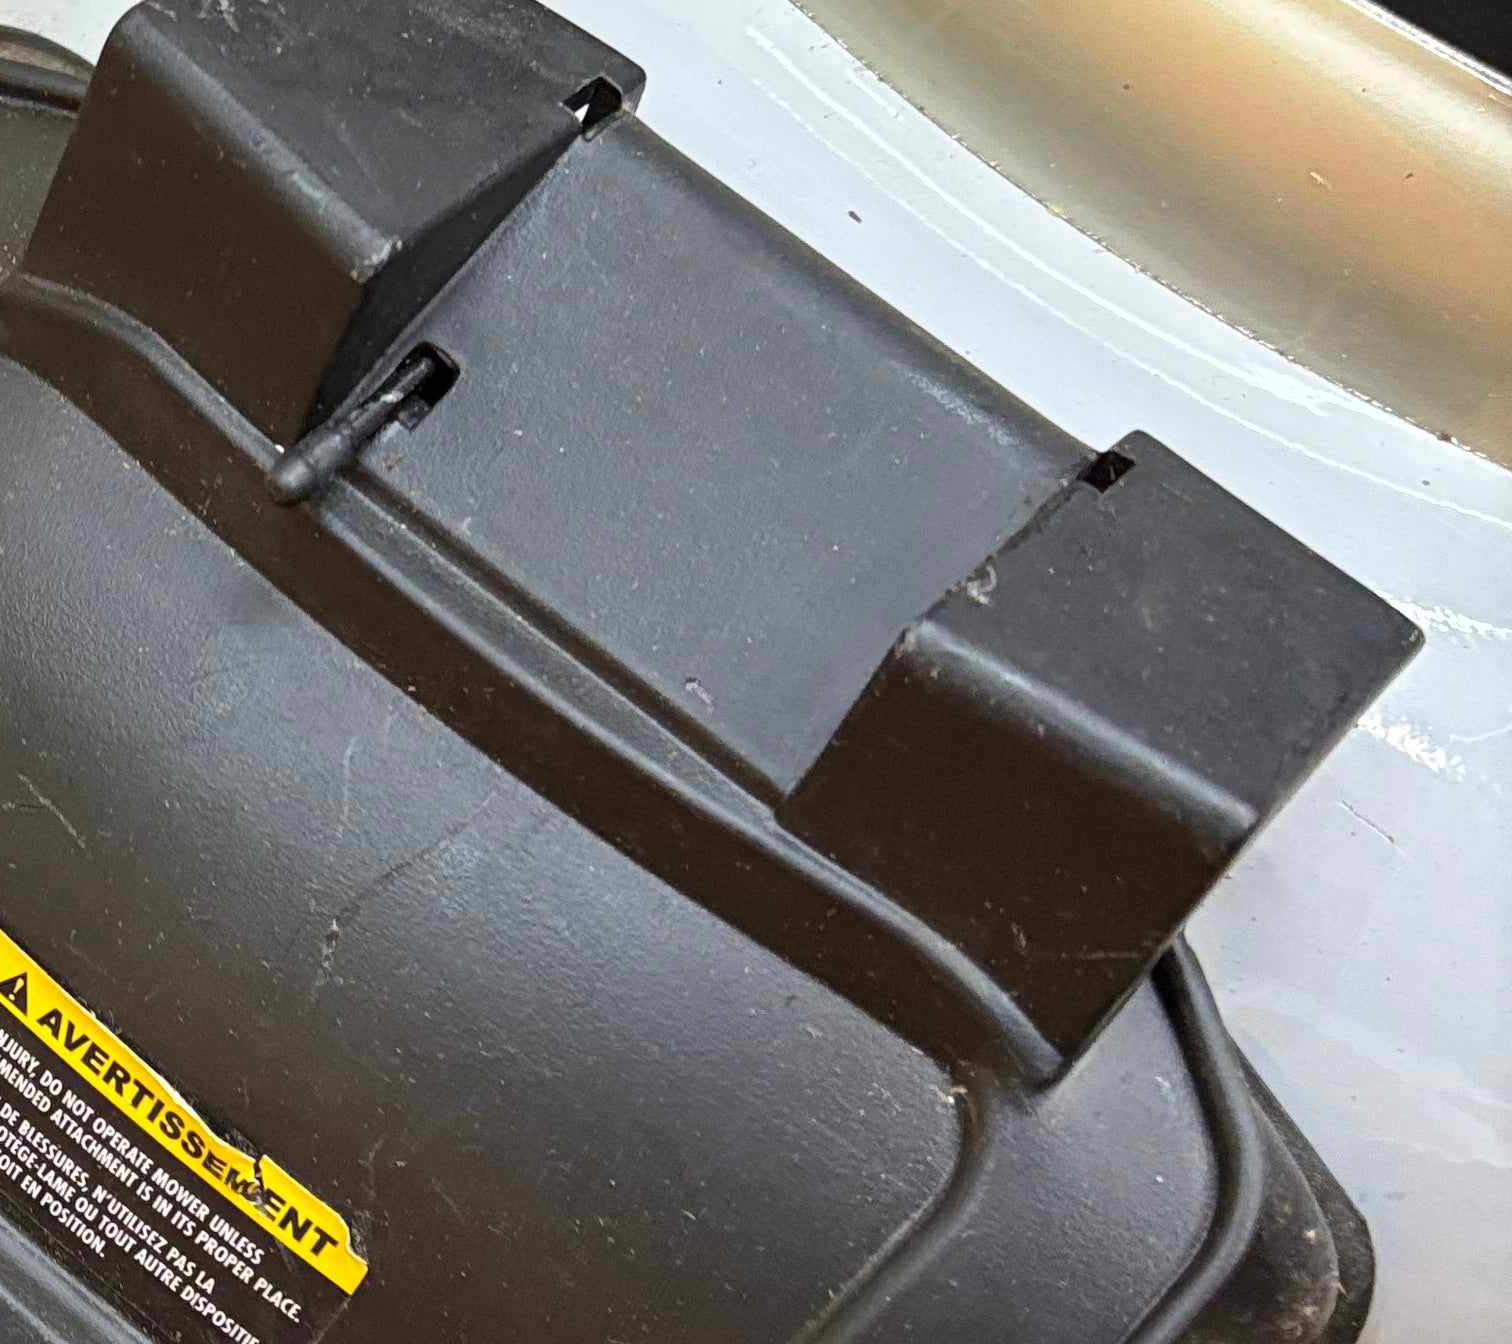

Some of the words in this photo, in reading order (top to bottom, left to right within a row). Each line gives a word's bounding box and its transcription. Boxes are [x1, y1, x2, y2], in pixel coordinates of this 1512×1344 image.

[17, 1118, 89, 1192] BLESSURES,
[164, 1245, 196, 1277] PAS
[194, 1269, 215, 1294] LA
[19, 1174, 42, 1199] EN
[39, 1191, 106, 1258] POSITION.
[36, 1008, 339, 1256] AVERTISSEMENT
[38, 1069, 63, 1096] DO
[60, 1089, 94, 1122] NOT
[91, 1116, 154, 1175] OPERATE
[150, 1167, 210, 1222] MOWER
[208, 1213, 265, 1264] UNLESS
[49, 1108, 139, 1187] ATTACHMENT
[135, 1180, 154, 1201] IS
[151, 1194, 173, 1217] IN
[170, 1209, 196, 1236] ITS
[193, 1229, 254, 1284] PROPER
[252, 1276, 301, 1323] PLACE.
[74, 1195, 99, 1221] OU
[97, 1213, 137, 1253] TOUT
[133, 1247, 183, 1292] AUTRE
